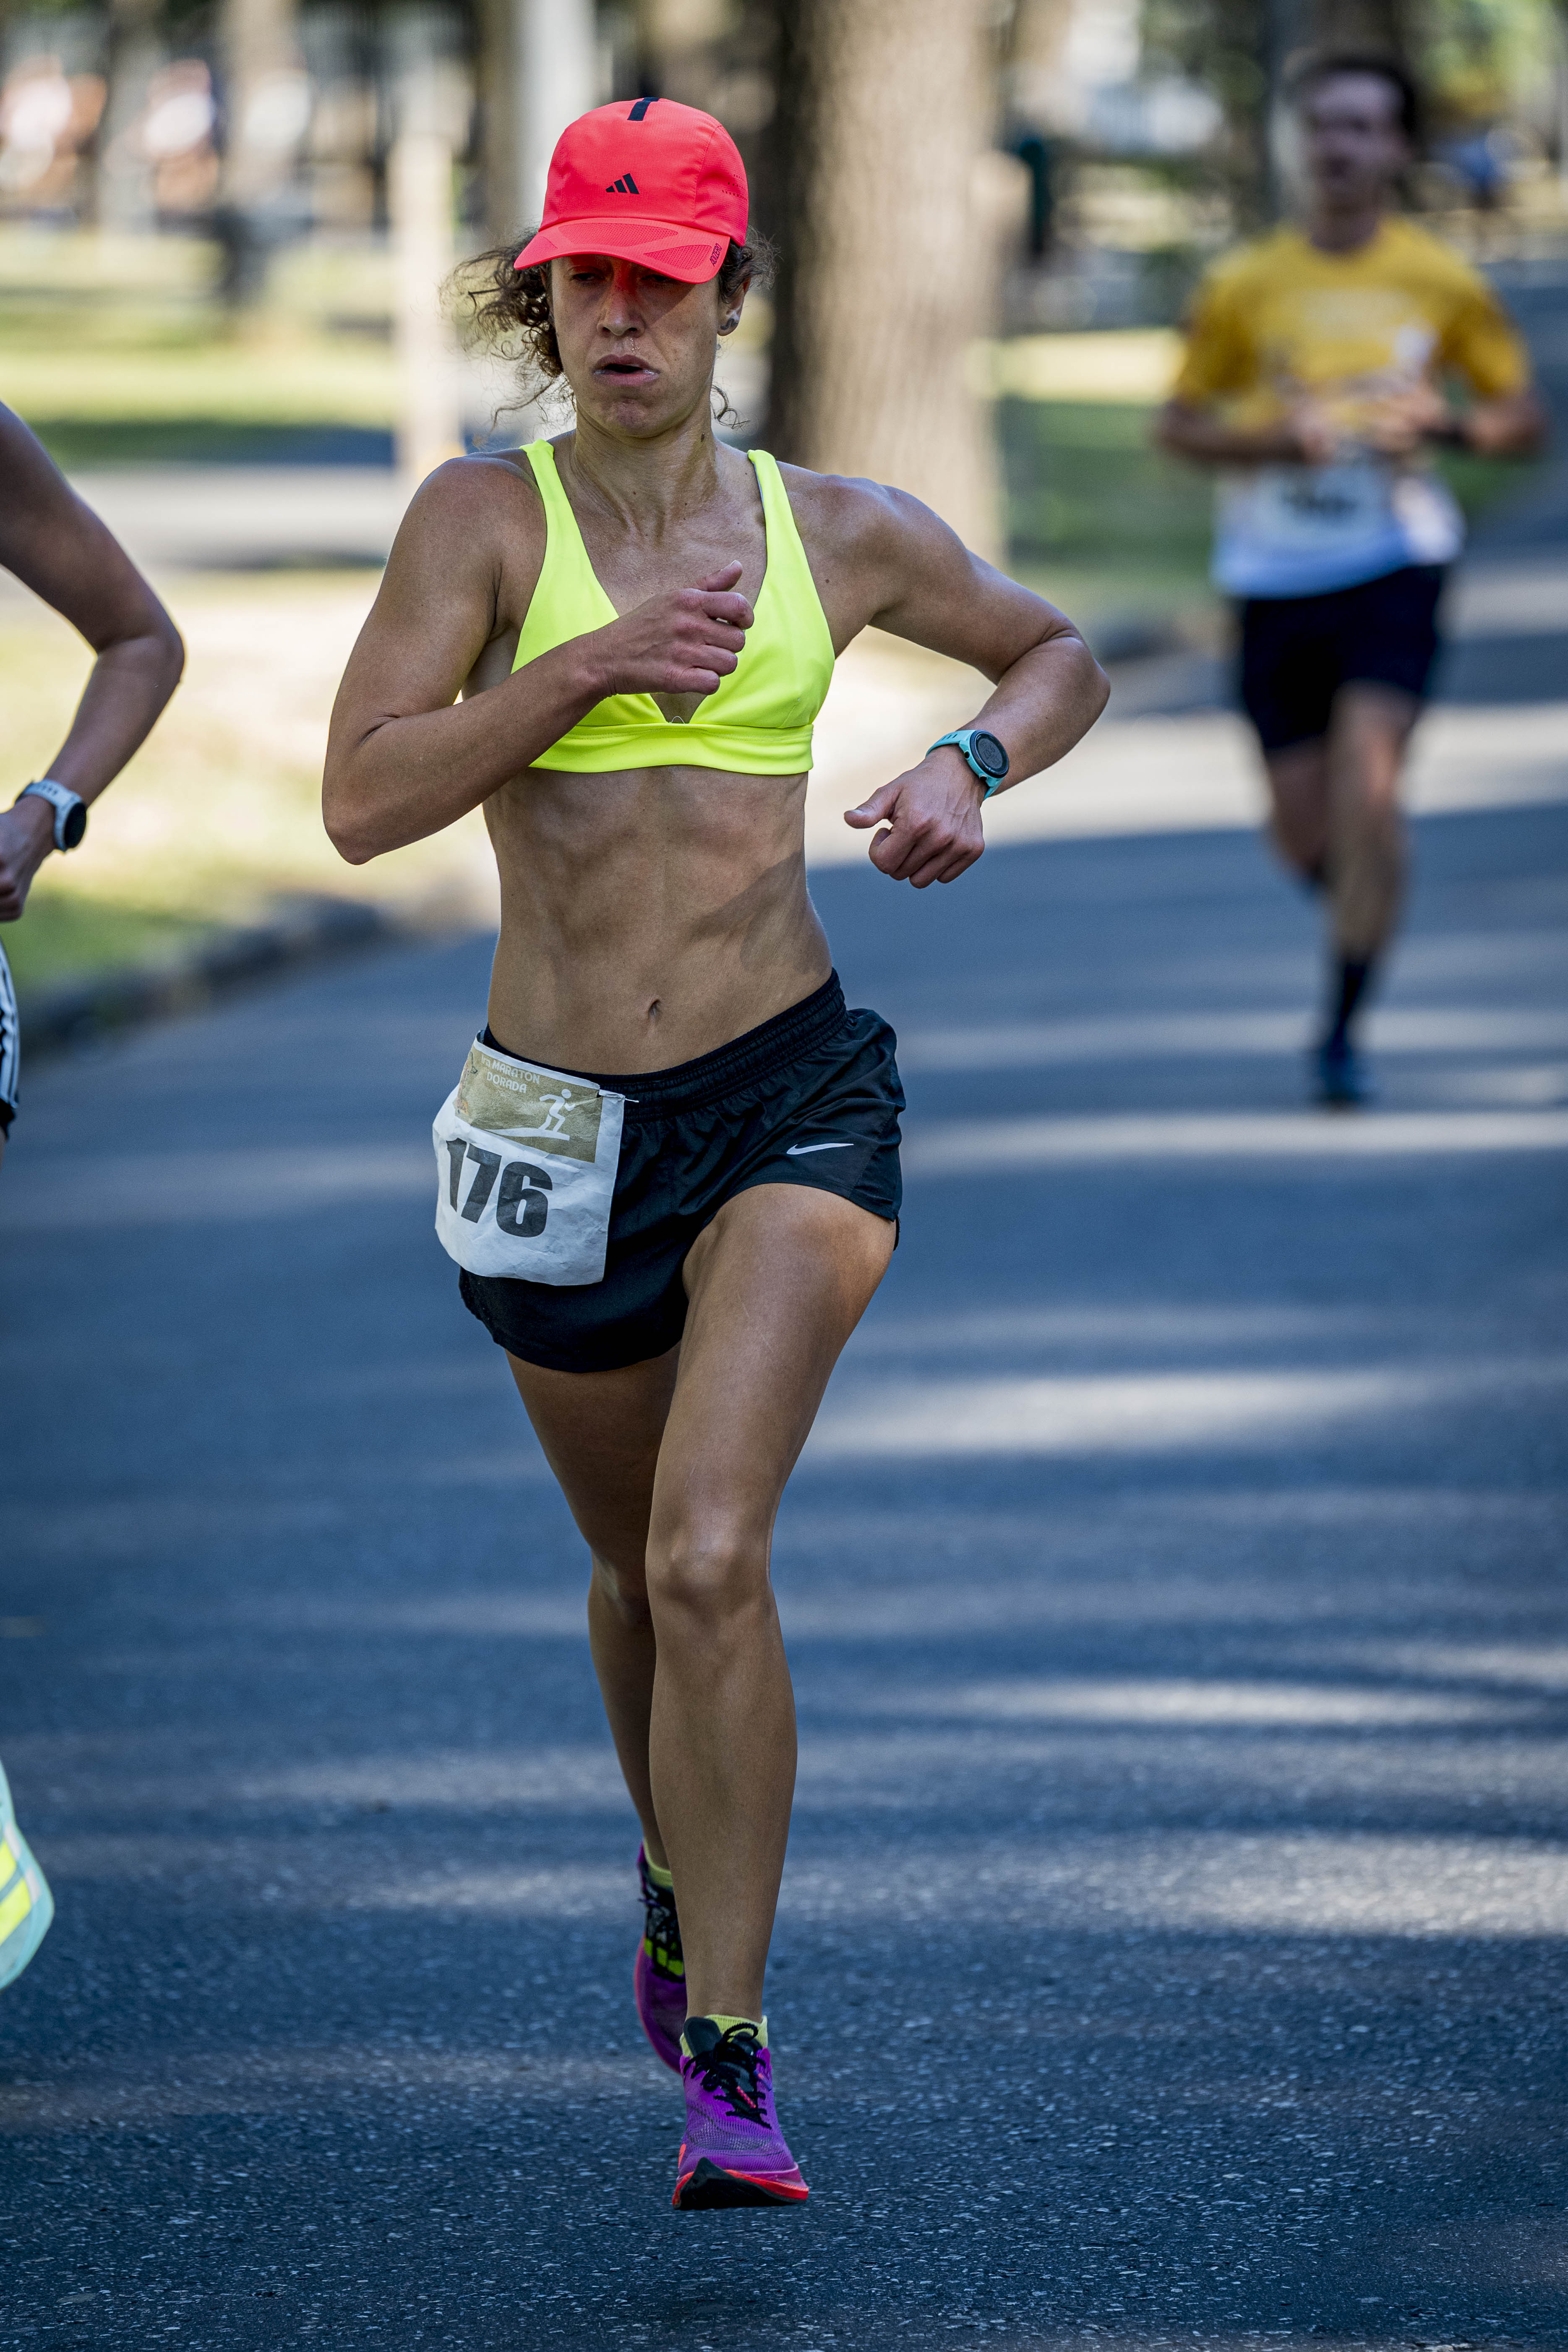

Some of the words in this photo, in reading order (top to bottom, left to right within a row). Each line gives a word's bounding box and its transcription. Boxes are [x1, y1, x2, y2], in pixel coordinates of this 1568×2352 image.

[710, 243, 722, 267] ADIZERO
[487, 1071, 527, 1094] DORADA
[492, 1060, 540, 1084] MARATON
[446, 1138, 553, 1238] 176
